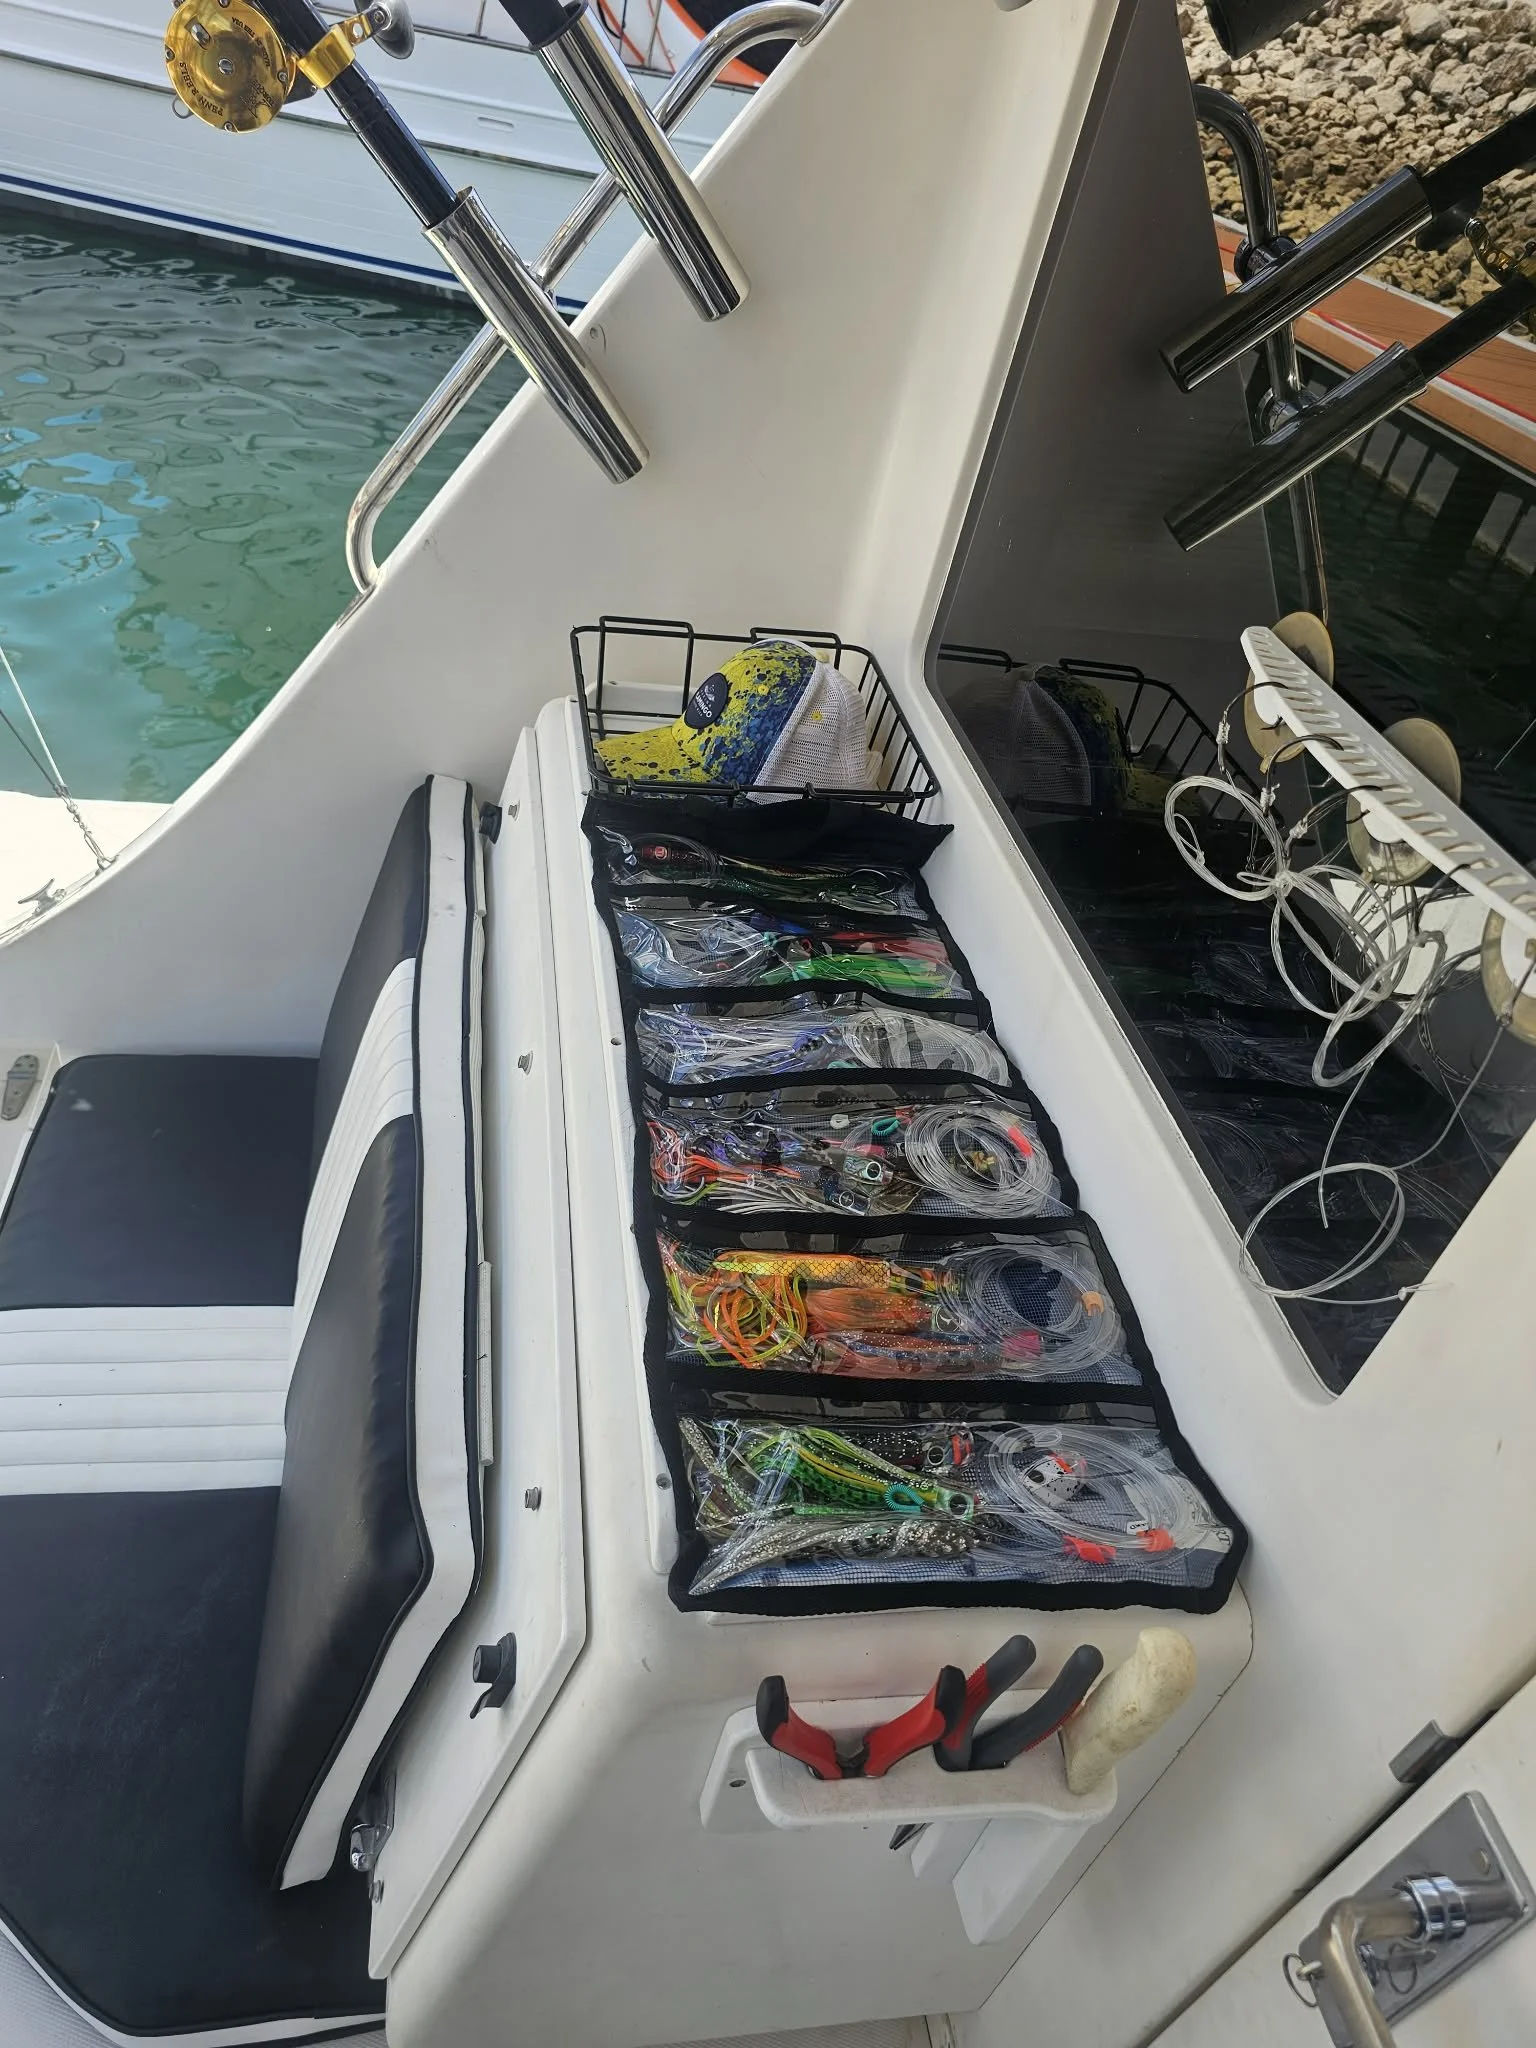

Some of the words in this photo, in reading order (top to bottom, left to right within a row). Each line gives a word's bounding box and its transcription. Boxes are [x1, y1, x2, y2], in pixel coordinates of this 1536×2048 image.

[231, 16, 244, 28] USA
[179, 62, 199, 95] REELS
[199, 97, 224, 117] PENN
